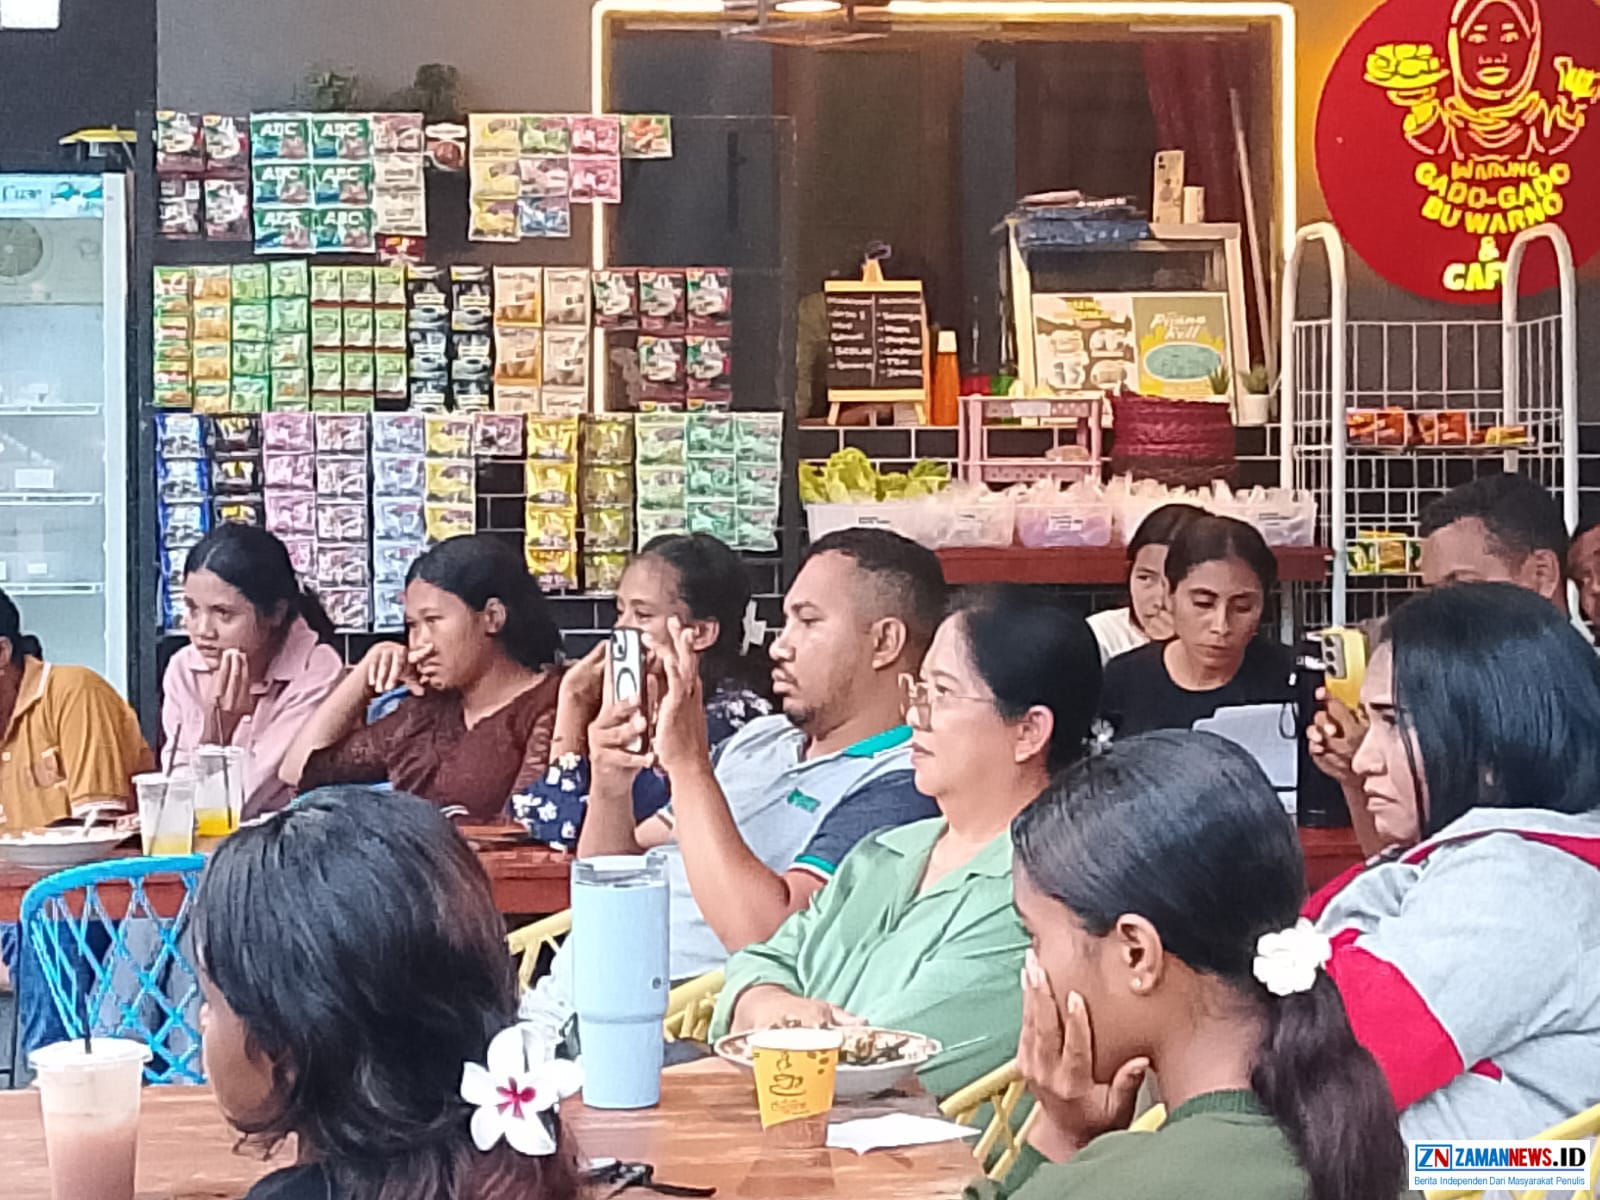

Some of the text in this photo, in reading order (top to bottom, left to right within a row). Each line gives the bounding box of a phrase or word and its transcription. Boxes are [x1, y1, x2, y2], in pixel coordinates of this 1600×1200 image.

[321, 122, 360, 137] ABC
[322, 167, 360, 180] ABC
[1451, 159, 1541, 180] WARUNG
[1415, 162, 1570, 209] GADO-GADO
[1421, 192, 1563, 235] BU WARNO
[1443, 261, 1506, 291] CAF
